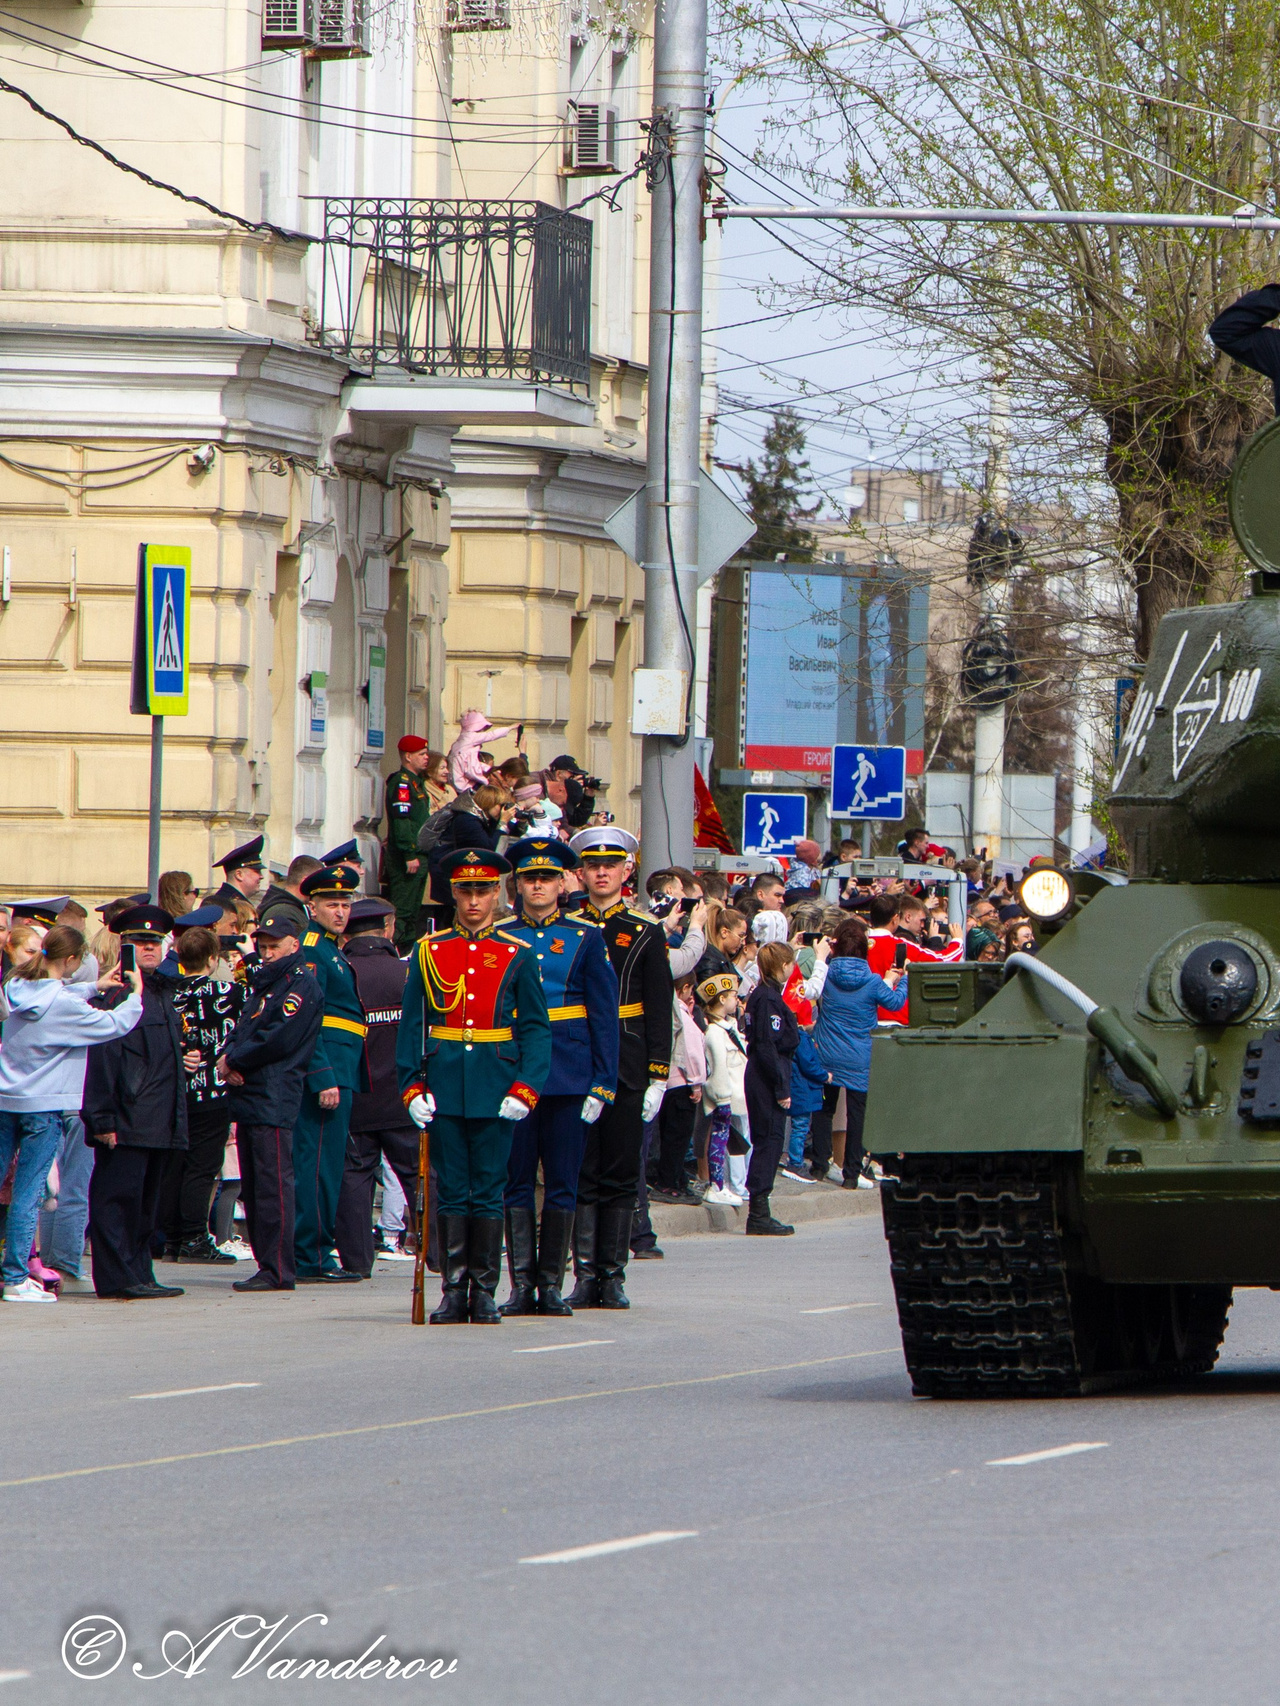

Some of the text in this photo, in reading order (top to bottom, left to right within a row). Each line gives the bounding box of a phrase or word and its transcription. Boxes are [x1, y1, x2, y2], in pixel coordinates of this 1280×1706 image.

[817, 634, 837, 649] Иван
[789, 656, 837, 672] Васильевич
[1220, 667, 1262, 724] 100
[1178, 713, 1201, 747] 29
[366, 1009, 403, 1023] ЛИЦИЯ
